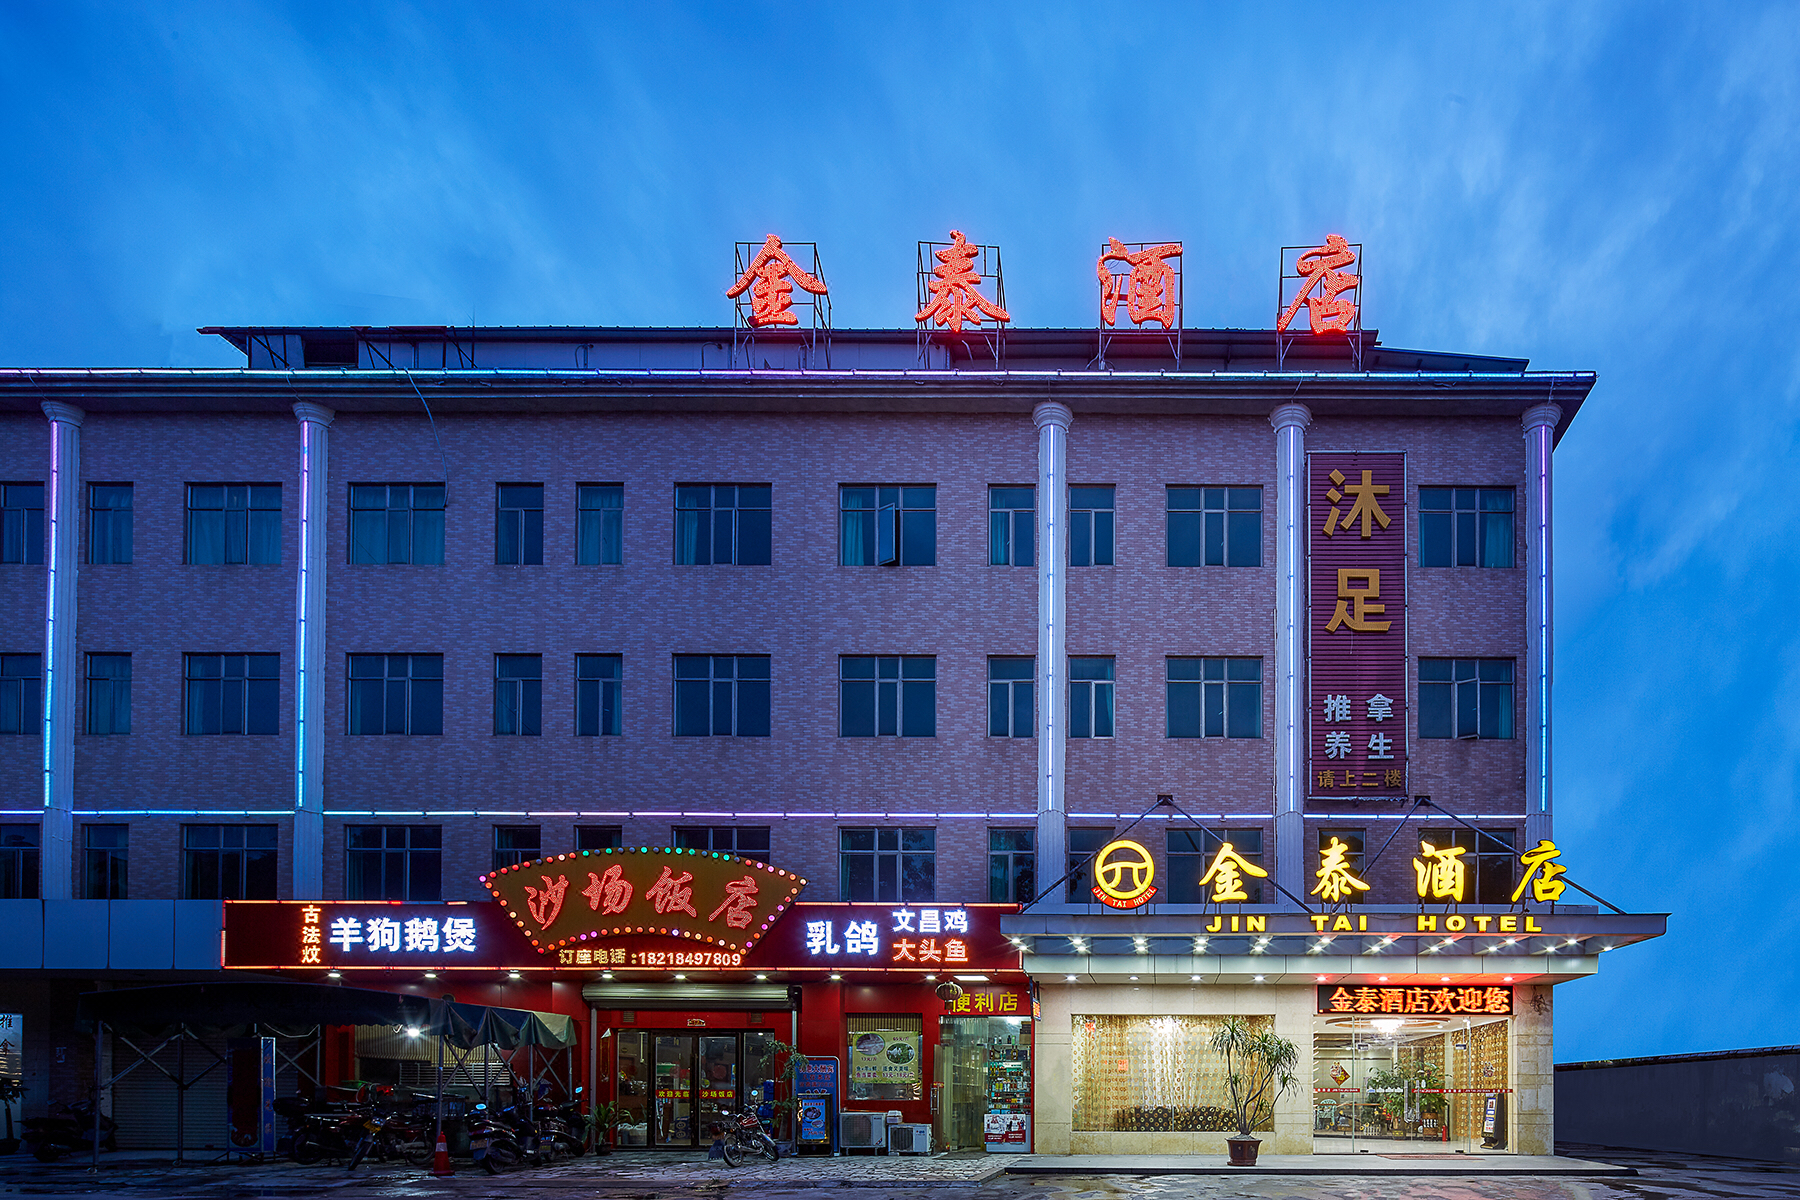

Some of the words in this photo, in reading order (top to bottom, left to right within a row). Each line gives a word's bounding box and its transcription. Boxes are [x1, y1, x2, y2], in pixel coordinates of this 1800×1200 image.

[726, 230, 1358, 336] 金泰酒店
[1322, 468, 1392, 634] 沐足
[1323, 693, 1394, 723] 推拿
[1324, 730, 1395, 760] 养生
[1317, 769, 1402, 788] 请上二楼
[1198, 836, 1569, 903] 金泰酒店
[524, 864, 760, 930] 沙场饭店
[1093, 888, 1107, 901] JIN
[1112, 899, 1127, 908] TAI
[1133, 888, 1157, 906] HOTEL
[301, 904, 322, 964] 古法炆
[329, 916, 477, 953] 羊狗鹅煲
[892, 908, 969, 933] 文昌鸡
[1205, 915, 1267, 933] JIN
[1311, 915, 1368, 933] TAI
[1417, 915, 1543, 933] HOTEL
[806, 919, 880, 956] 乳鸽
[892, 938, 969, 963] 大头鱼
[1328, 985, 1512, 1014] 金泰酒店欢迎您
